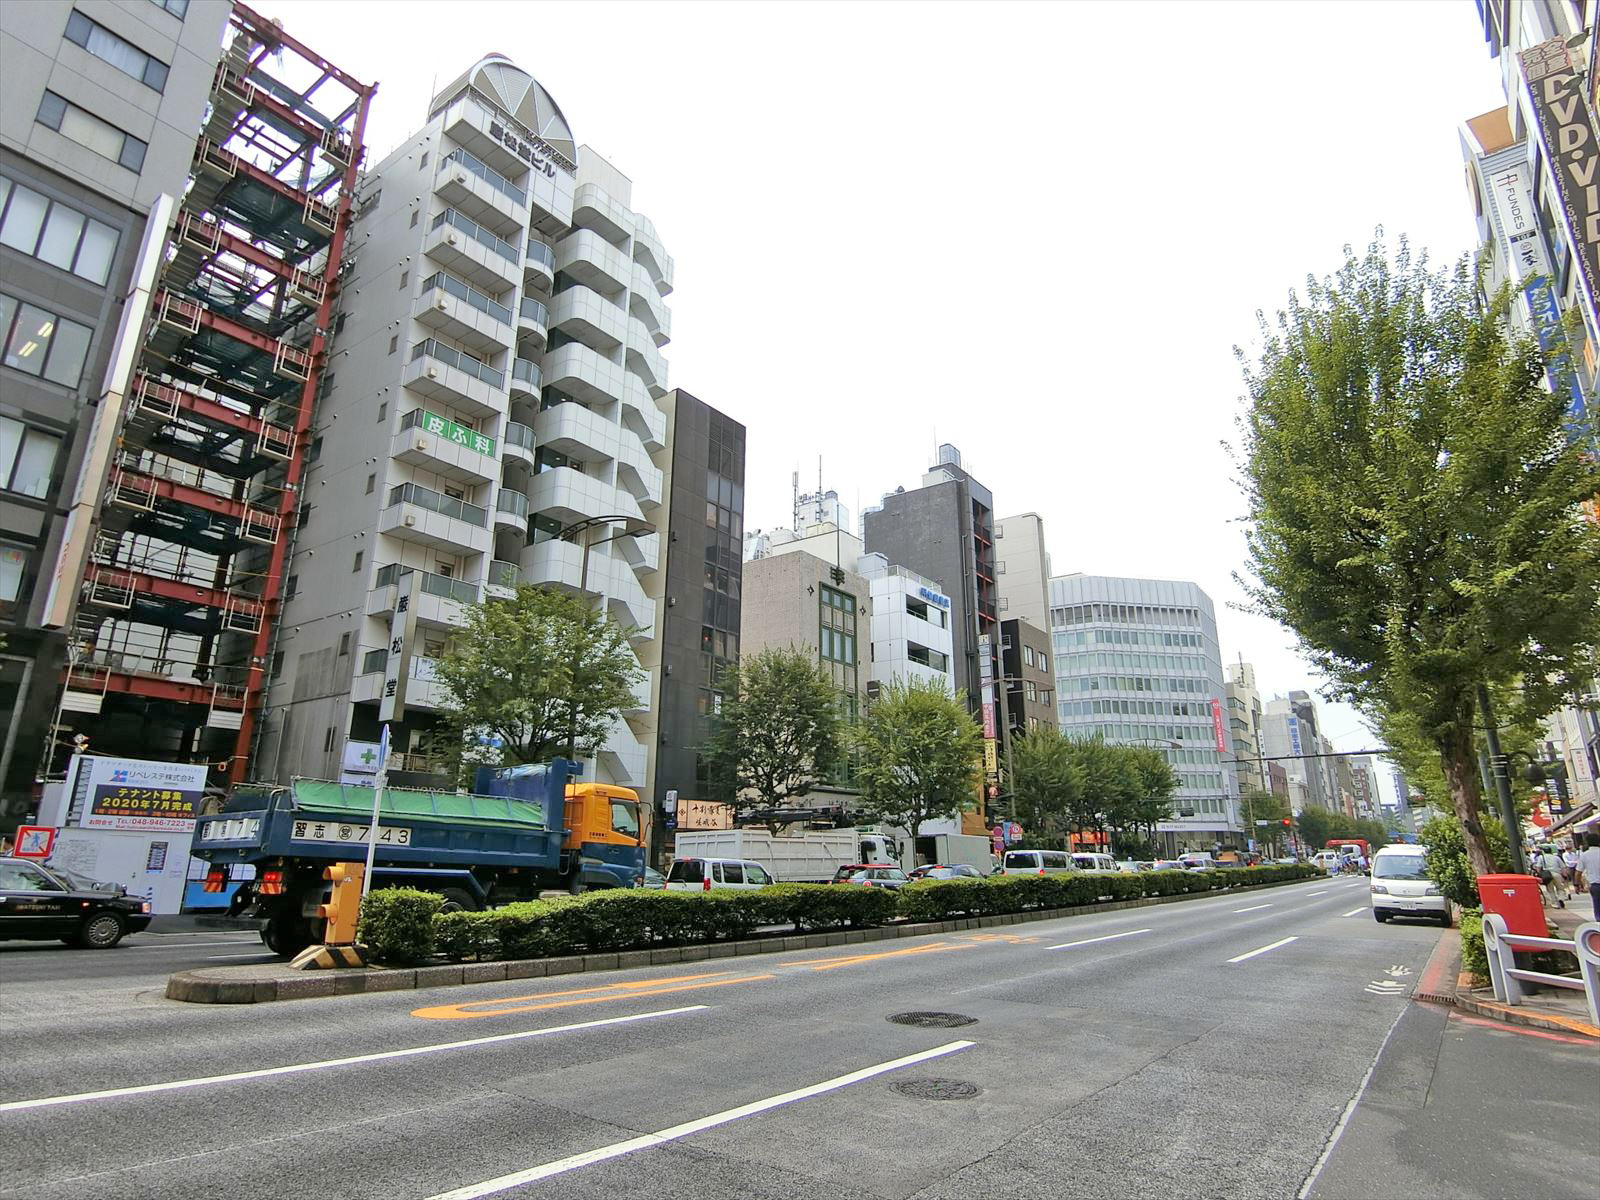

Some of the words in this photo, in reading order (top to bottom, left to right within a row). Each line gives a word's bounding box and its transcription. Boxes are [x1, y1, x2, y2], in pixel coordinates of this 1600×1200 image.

[1506, 187, 1525, 230] FUNDES
[427, 417, 490, 454] 皮ふ科
[102, 797, 193, 812] 2020年7月完成
[118, 788, 182, 801] テナント募集
